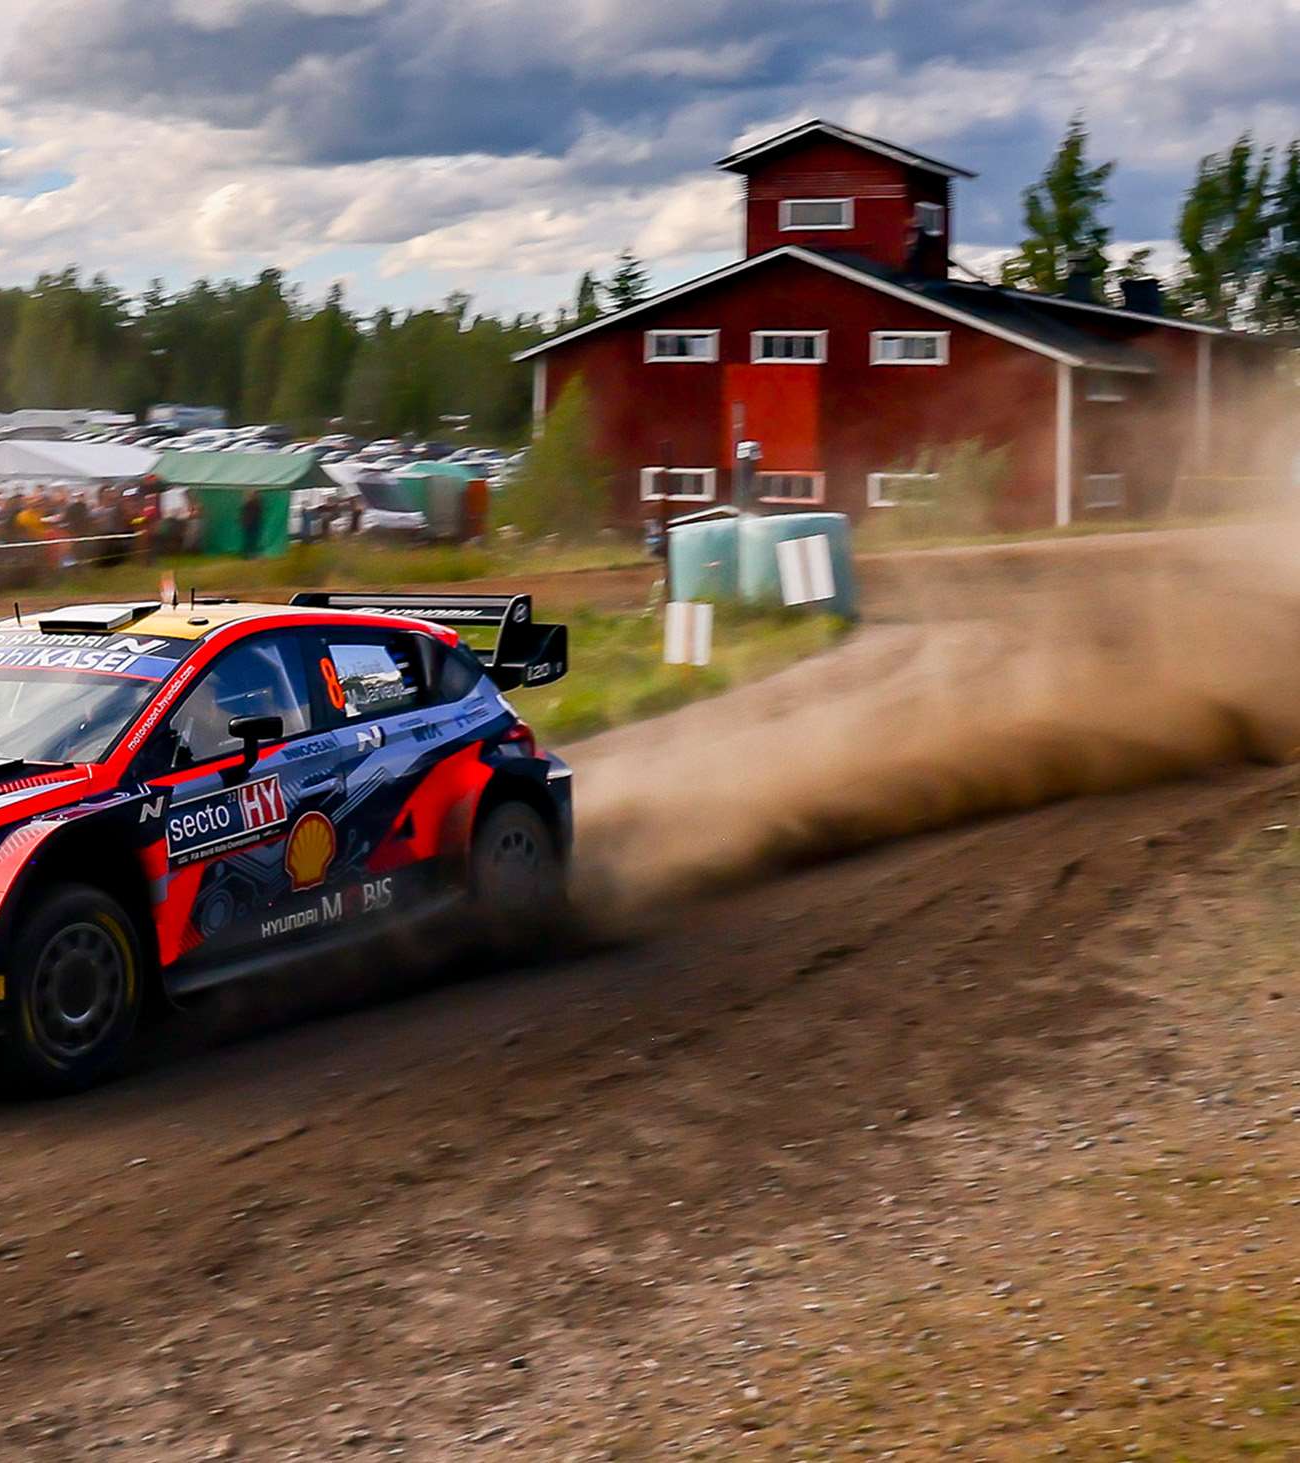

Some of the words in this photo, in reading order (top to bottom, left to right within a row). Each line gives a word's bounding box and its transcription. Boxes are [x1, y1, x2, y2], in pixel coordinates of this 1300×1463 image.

[5, 634, 109, 648] HYUNDAI
[319, 656, 345, 710] 8
[241, 778, 281, 829] HY
[169, 804, 230, 842] secto
[260, 907, 319, 939] HYUNDAI
